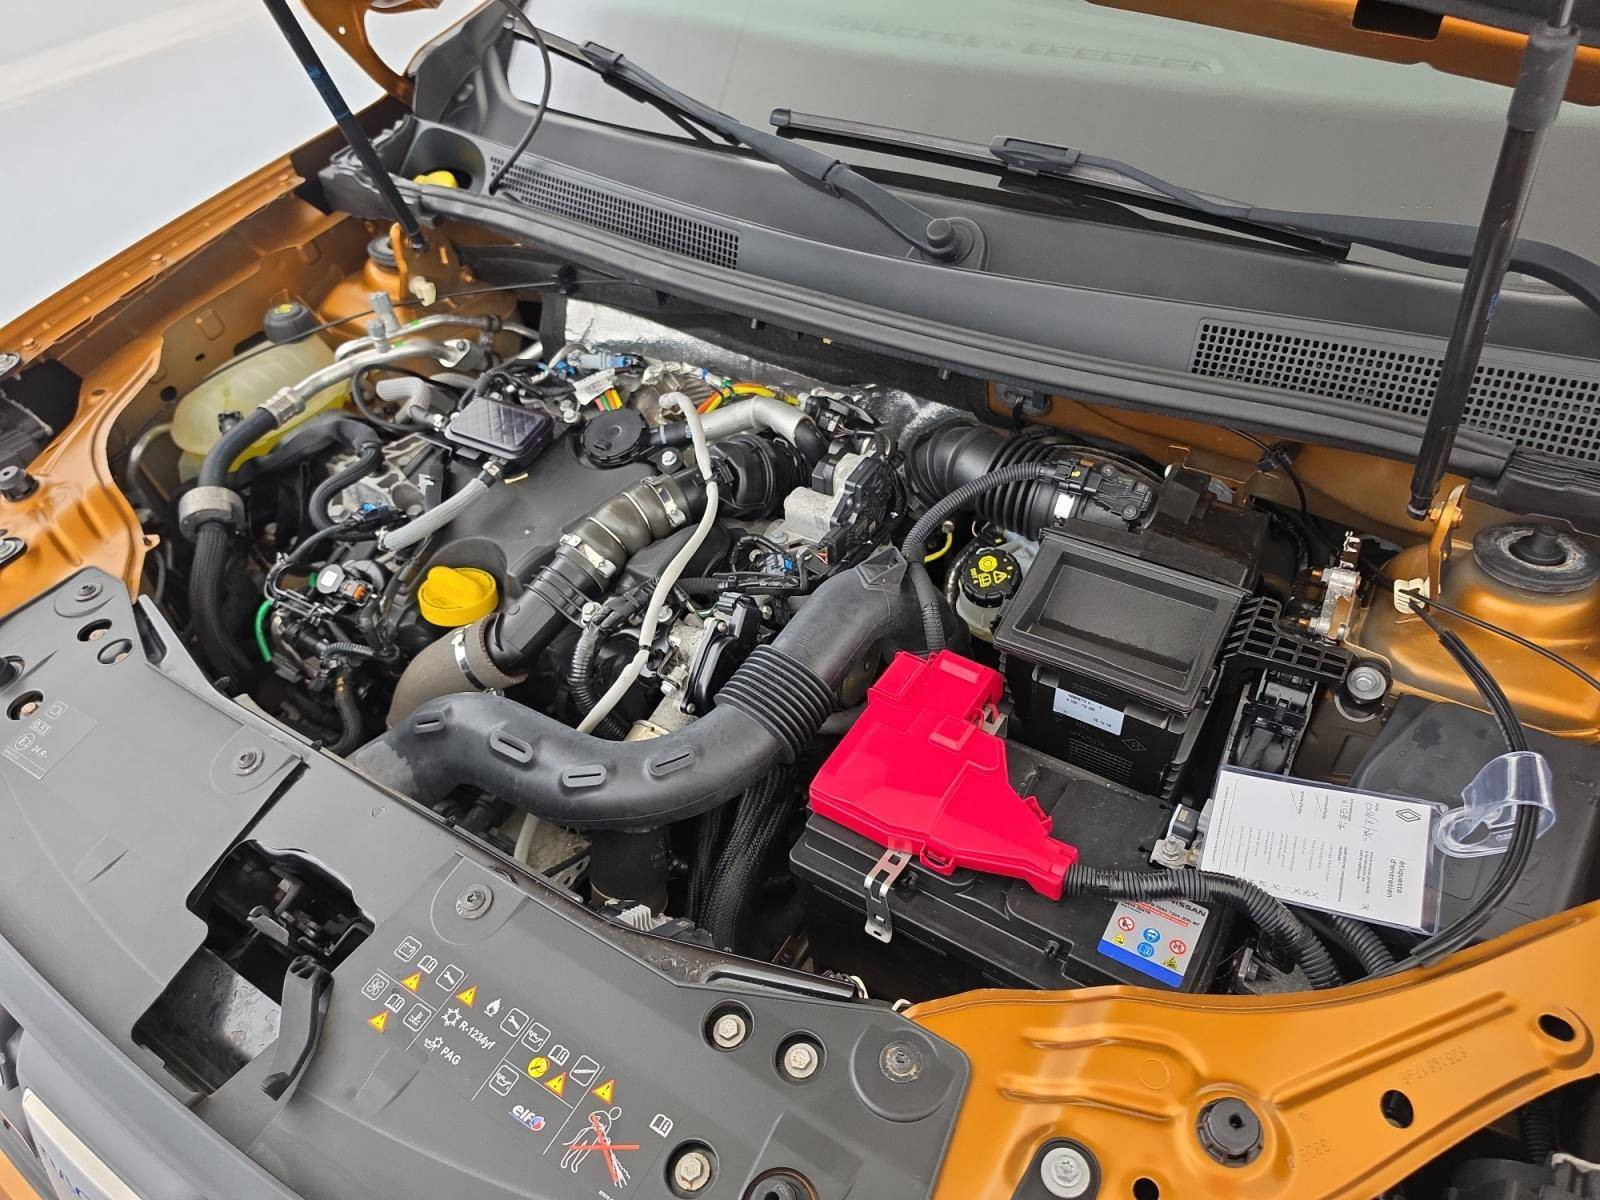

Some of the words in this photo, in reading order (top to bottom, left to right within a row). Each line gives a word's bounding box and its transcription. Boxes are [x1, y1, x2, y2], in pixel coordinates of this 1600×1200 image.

[970, 567, 978, 579] DOT
[1386, 858, 1397, 898] d'entretien
[1396, 860, 1407, 894] étiquette
[1170, 899, 1206, 917] NISSAN
[458, 1020, 496, 1050] R-1234yf
[440, 1046, 462, 1065] PAG
[512, 1104, 536, 1122] elf
